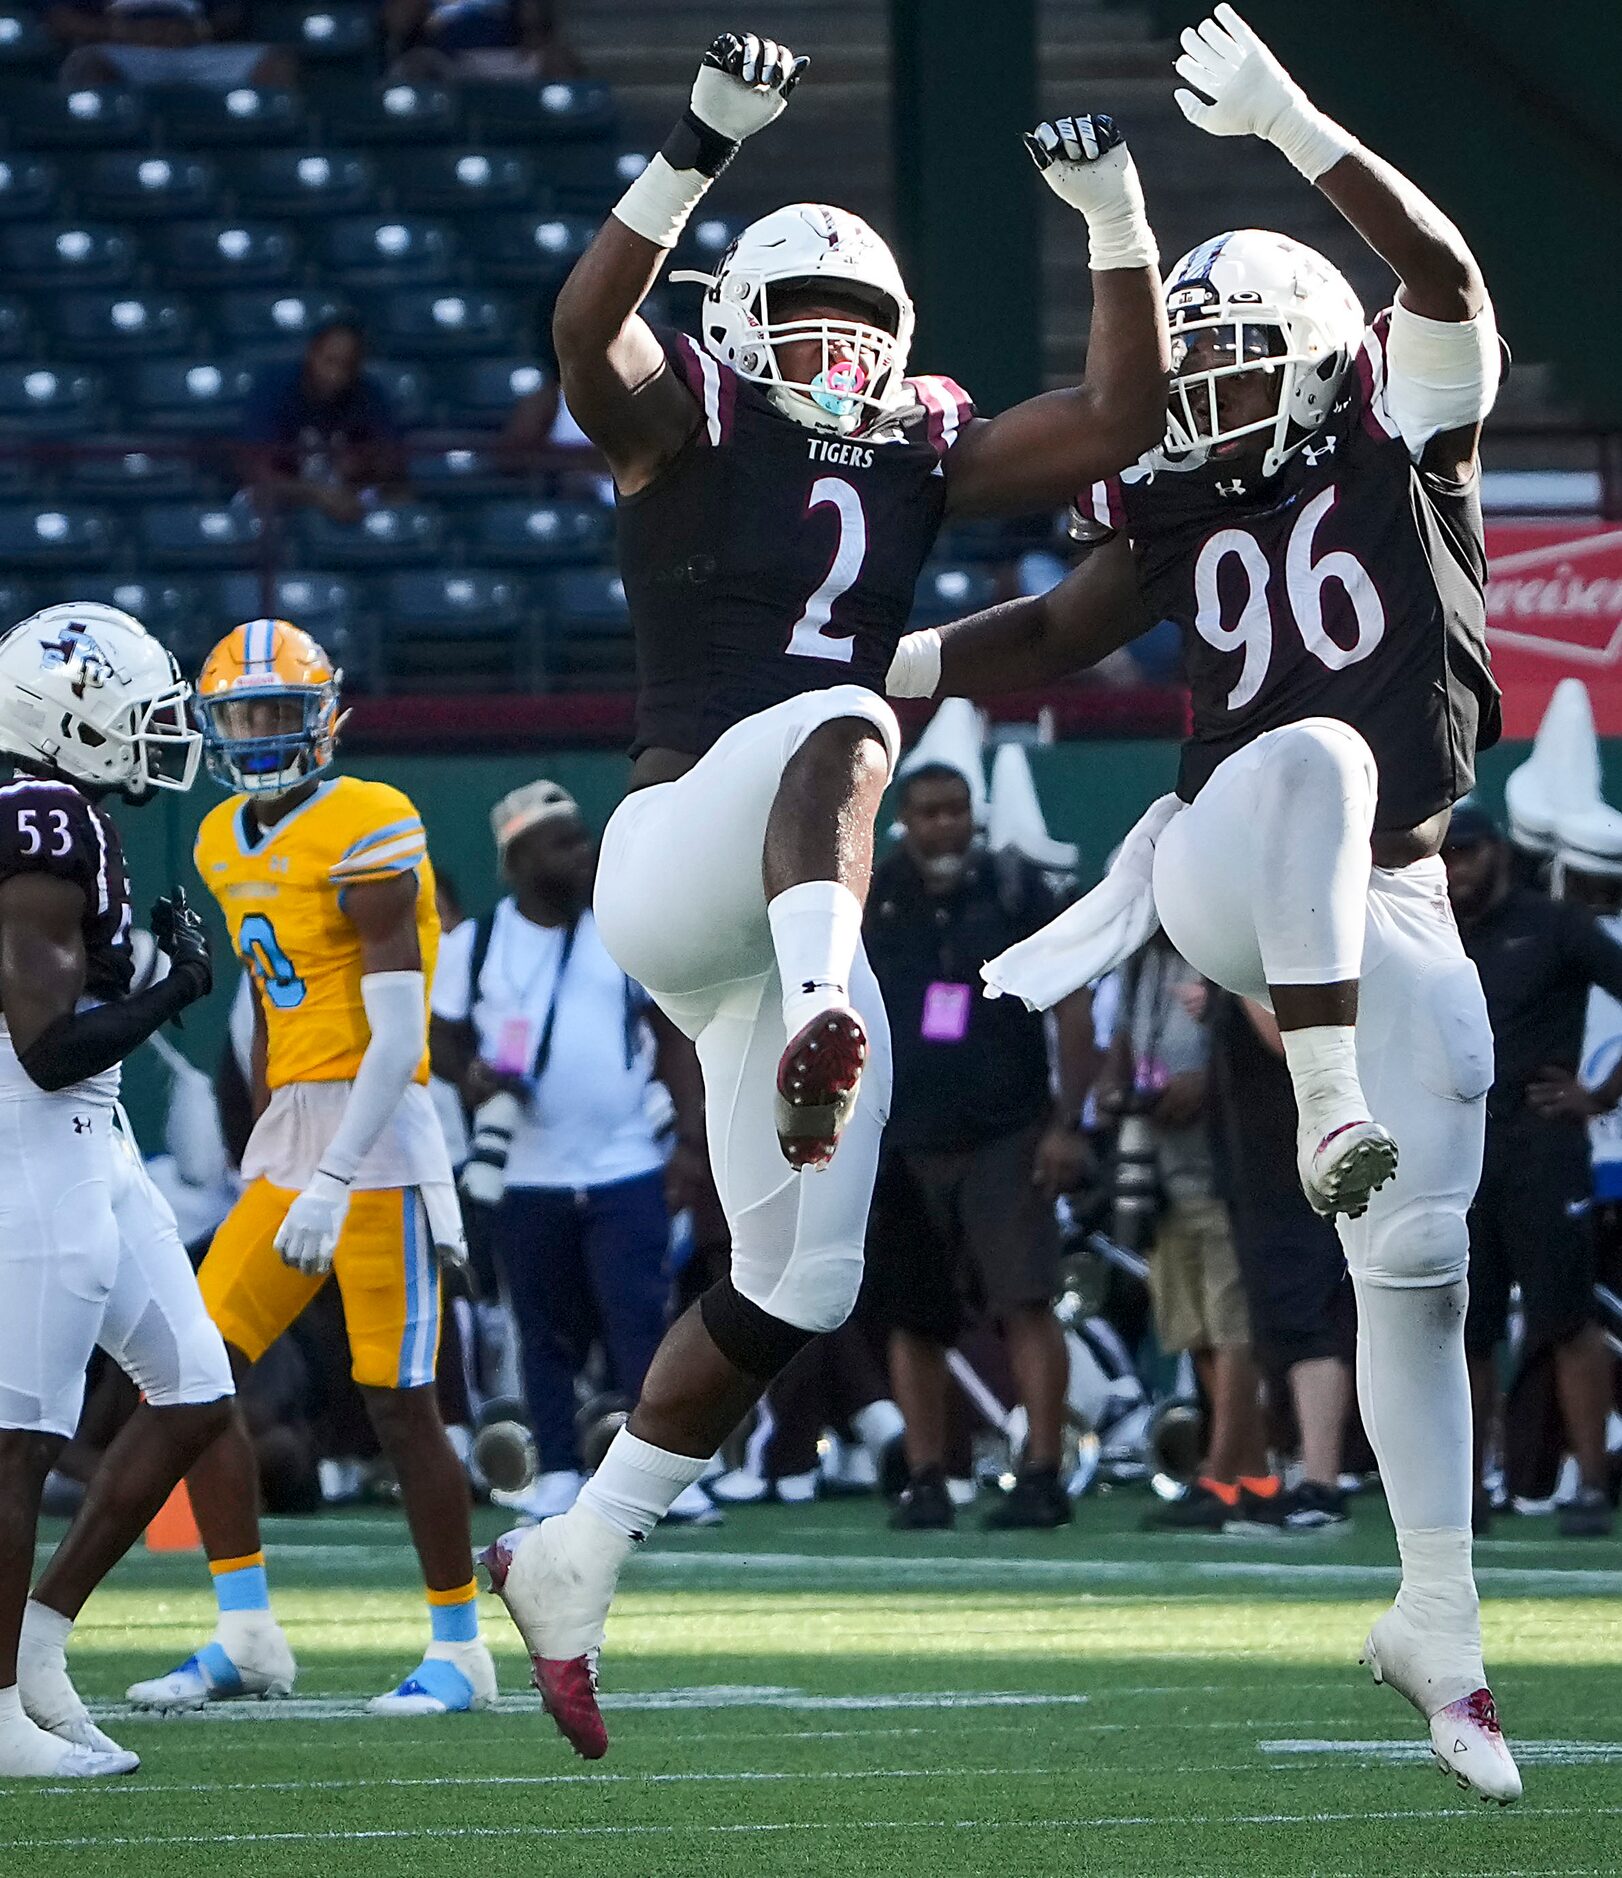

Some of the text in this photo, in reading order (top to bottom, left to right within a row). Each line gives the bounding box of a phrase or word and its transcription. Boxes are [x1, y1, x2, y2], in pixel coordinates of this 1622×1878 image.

[807, 438, 875, 468] TIGERS
[784, 476, 867, 663] 2
[1195, 484, 1385, 710] 96
[17, 809, 73, 856] 53
[239, 912, 307, 1008] 0
